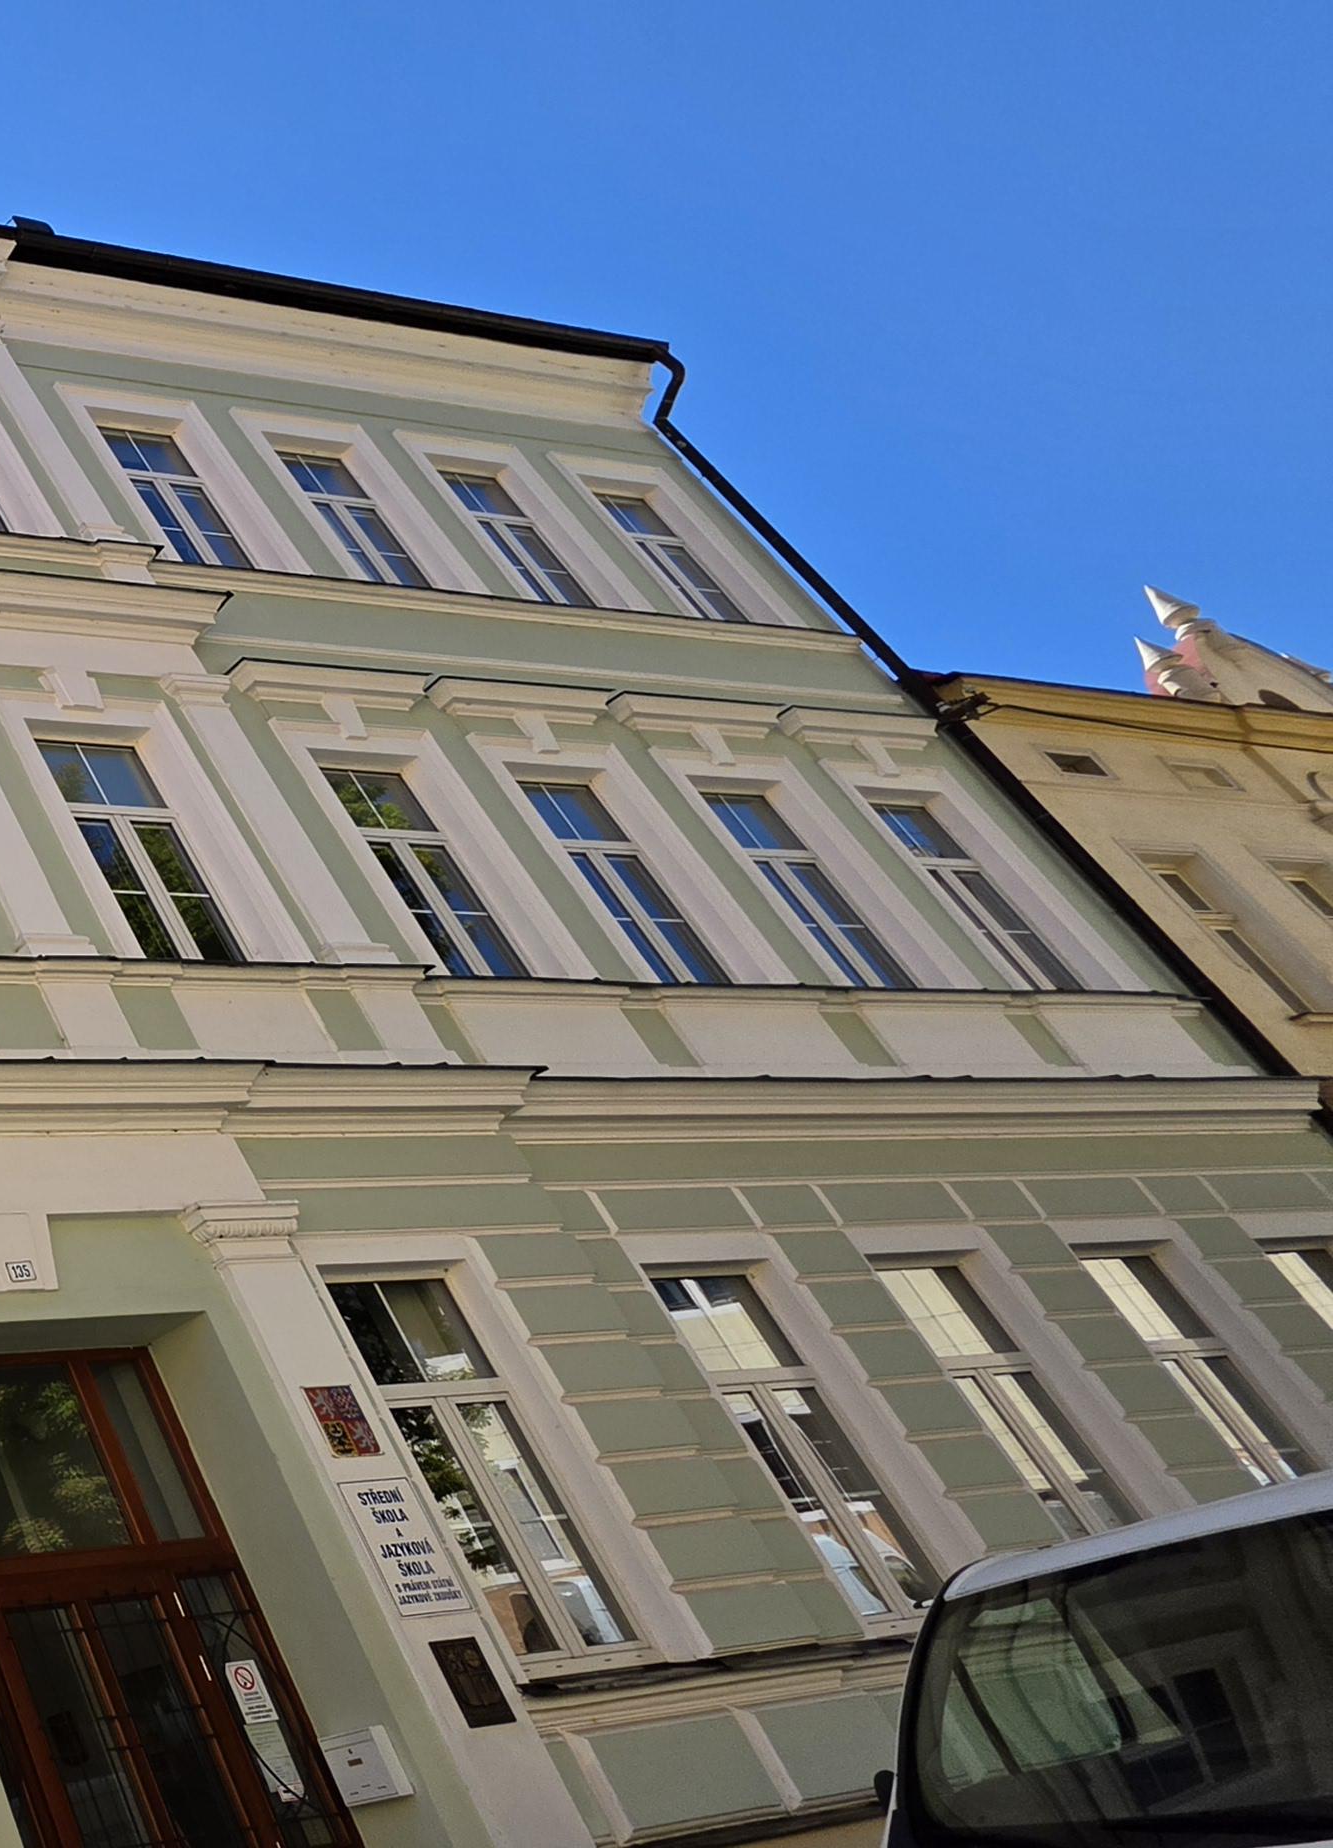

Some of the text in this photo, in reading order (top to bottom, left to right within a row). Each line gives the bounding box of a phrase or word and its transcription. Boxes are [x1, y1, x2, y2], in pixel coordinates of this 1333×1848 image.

[12, 1264, 31, 1278] 135
[357, 1486, 404, 1506] STŘEDNÍ
[370, 1507, 409, 1524] ŠKOLA
[395, 1527, 403, 1537] A
[380, 1537, 435, 1559] JAZYKOVÁ
[396, 1560, 436, 1577] ŠKOLA
[402, 1579, 431, 1593] PRÁVEM
[398, 1590, 433, 1605] JAZYKOVÉ
